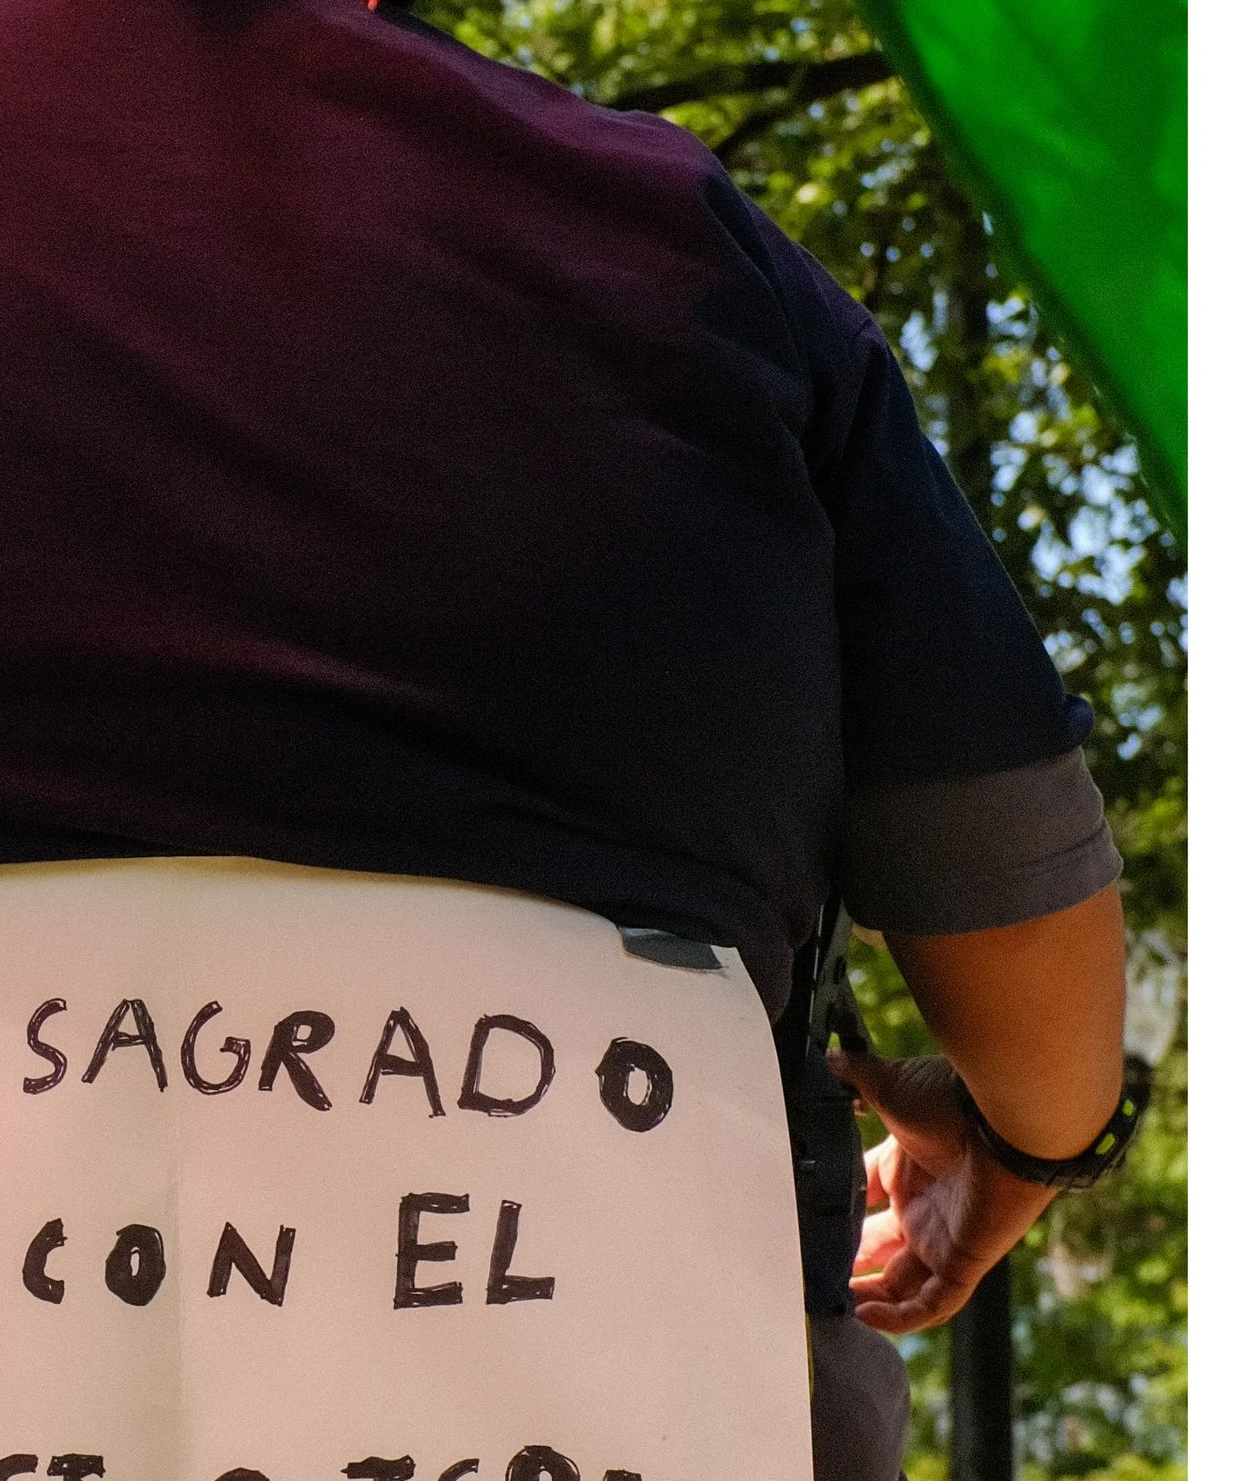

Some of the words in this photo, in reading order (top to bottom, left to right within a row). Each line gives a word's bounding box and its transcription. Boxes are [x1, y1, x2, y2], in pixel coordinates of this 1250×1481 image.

[24, 999, 673, 1133] SAGRADO
[23, 1218, 296, 1307] CON
[394, 1192, 555, 1310] EL
